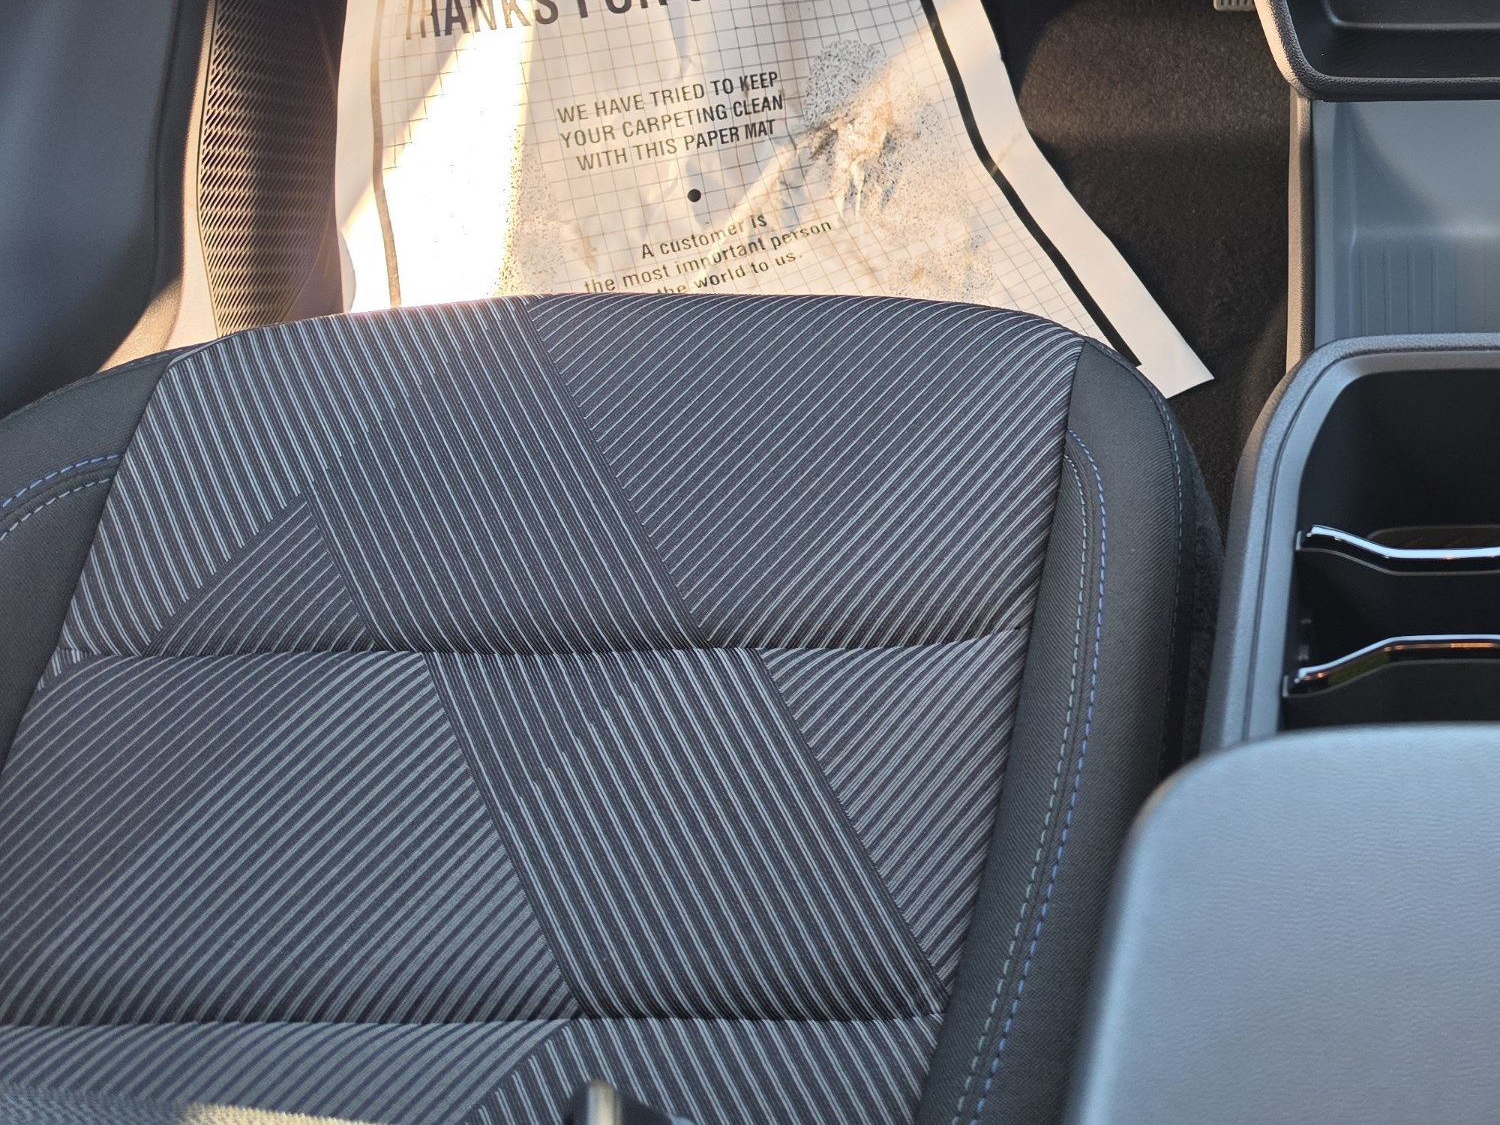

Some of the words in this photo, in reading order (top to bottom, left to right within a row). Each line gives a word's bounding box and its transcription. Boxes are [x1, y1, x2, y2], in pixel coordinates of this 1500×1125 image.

[556, 105, 588, 125] WE
[594, 94, 646, 120] HAVE
[649, 82, 706, 109] TRIED
[710, 77, 735, 97] TO
[738, 70, 778, 92] KEEP
[560, 125, 617, 149] YOUR
[621, 104, 729, 140] CARPETING
[732, 93, 784, 117] CLEAN
[576, 145, 629, 172] WITH
[632, 137, 678, 162] THIS
[683, 125, 742, 152] PAPER
[743, 118, 776, 139] MAT
[622, 265, 669, 288] most
[770, 220, 833, 250] person
[641, 243, 655, 259] A
[660, 221, 745, 255] customer
[751, 213, 768, 229] is
[693, 265, 747, 290] world
[751, 260, 769, 274] to
